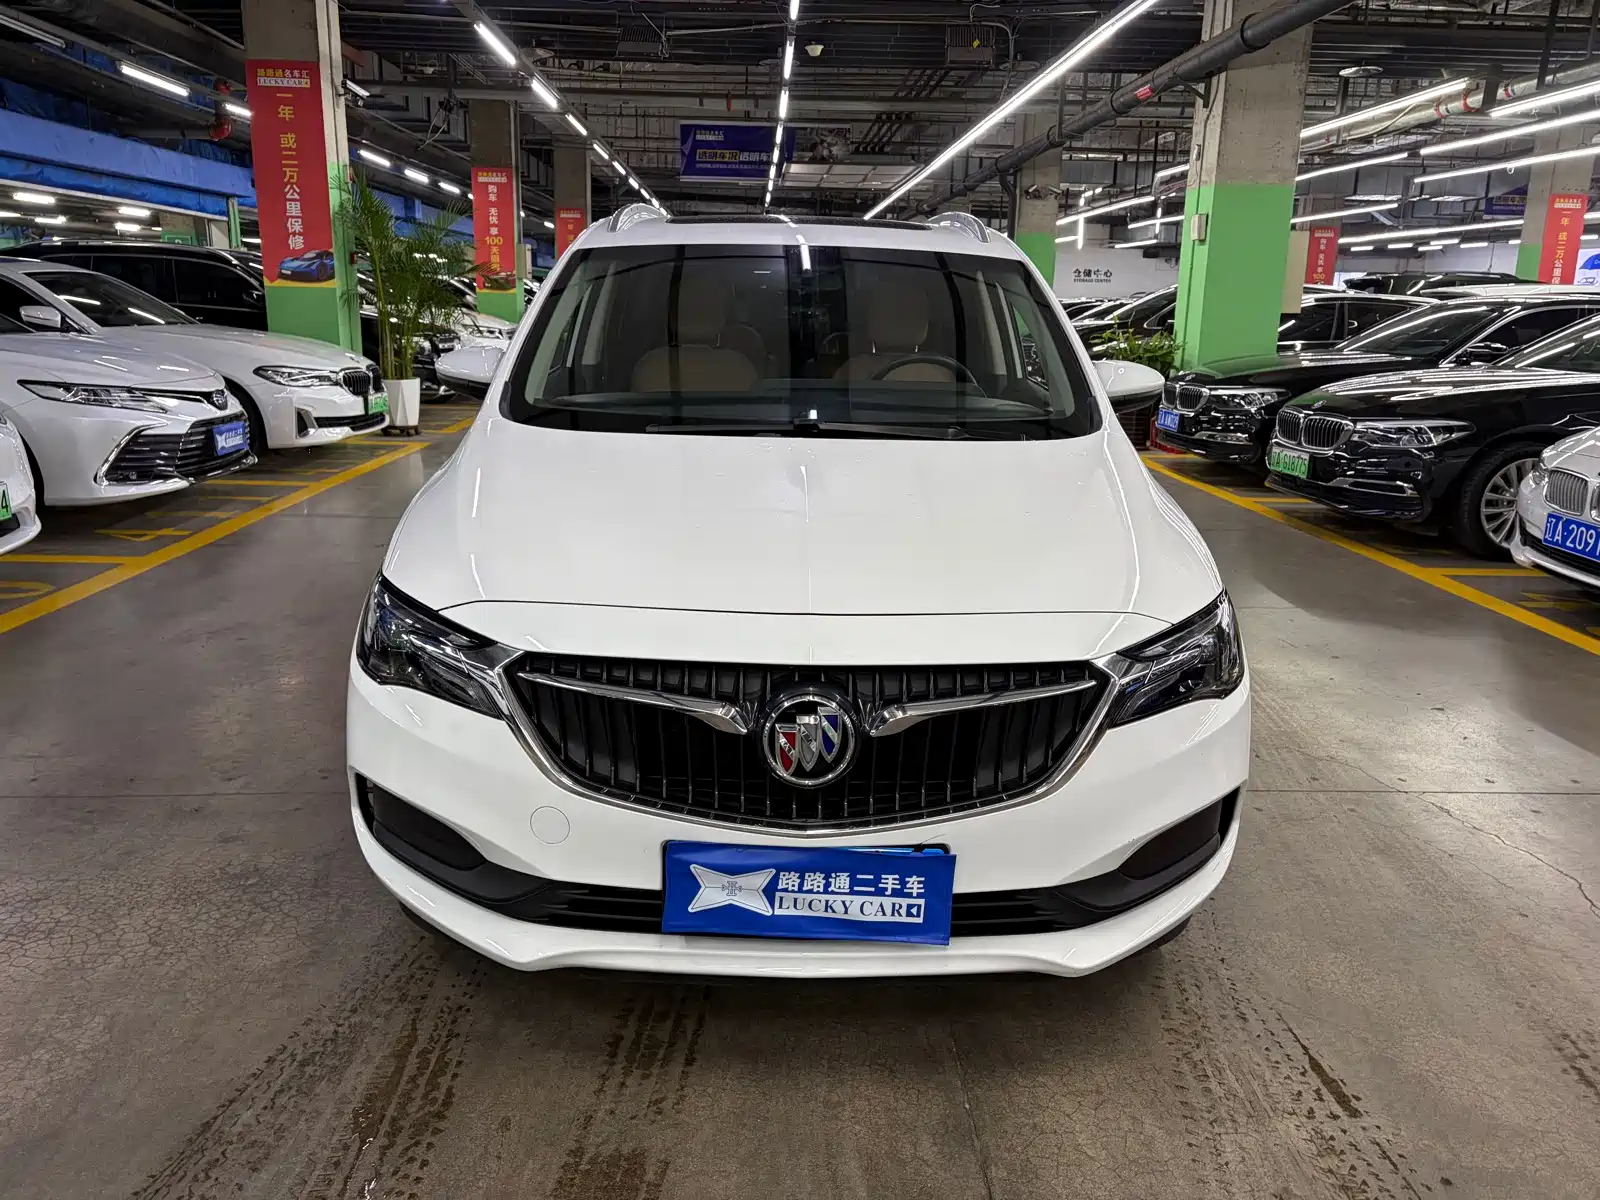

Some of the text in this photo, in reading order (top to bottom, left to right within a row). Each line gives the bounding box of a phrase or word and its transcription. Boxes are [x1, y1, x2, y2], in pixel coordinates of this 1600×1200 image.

[258, 78, 303, 87] LUCKY CAR
[1073, 268, 1113, 278] 仓储中心
[1544, 517, 1600, 557] 辽A·209
[778, 872, 925, 896] 路路通二手车
[778, 896, 904, 918] LUCKY CAR
